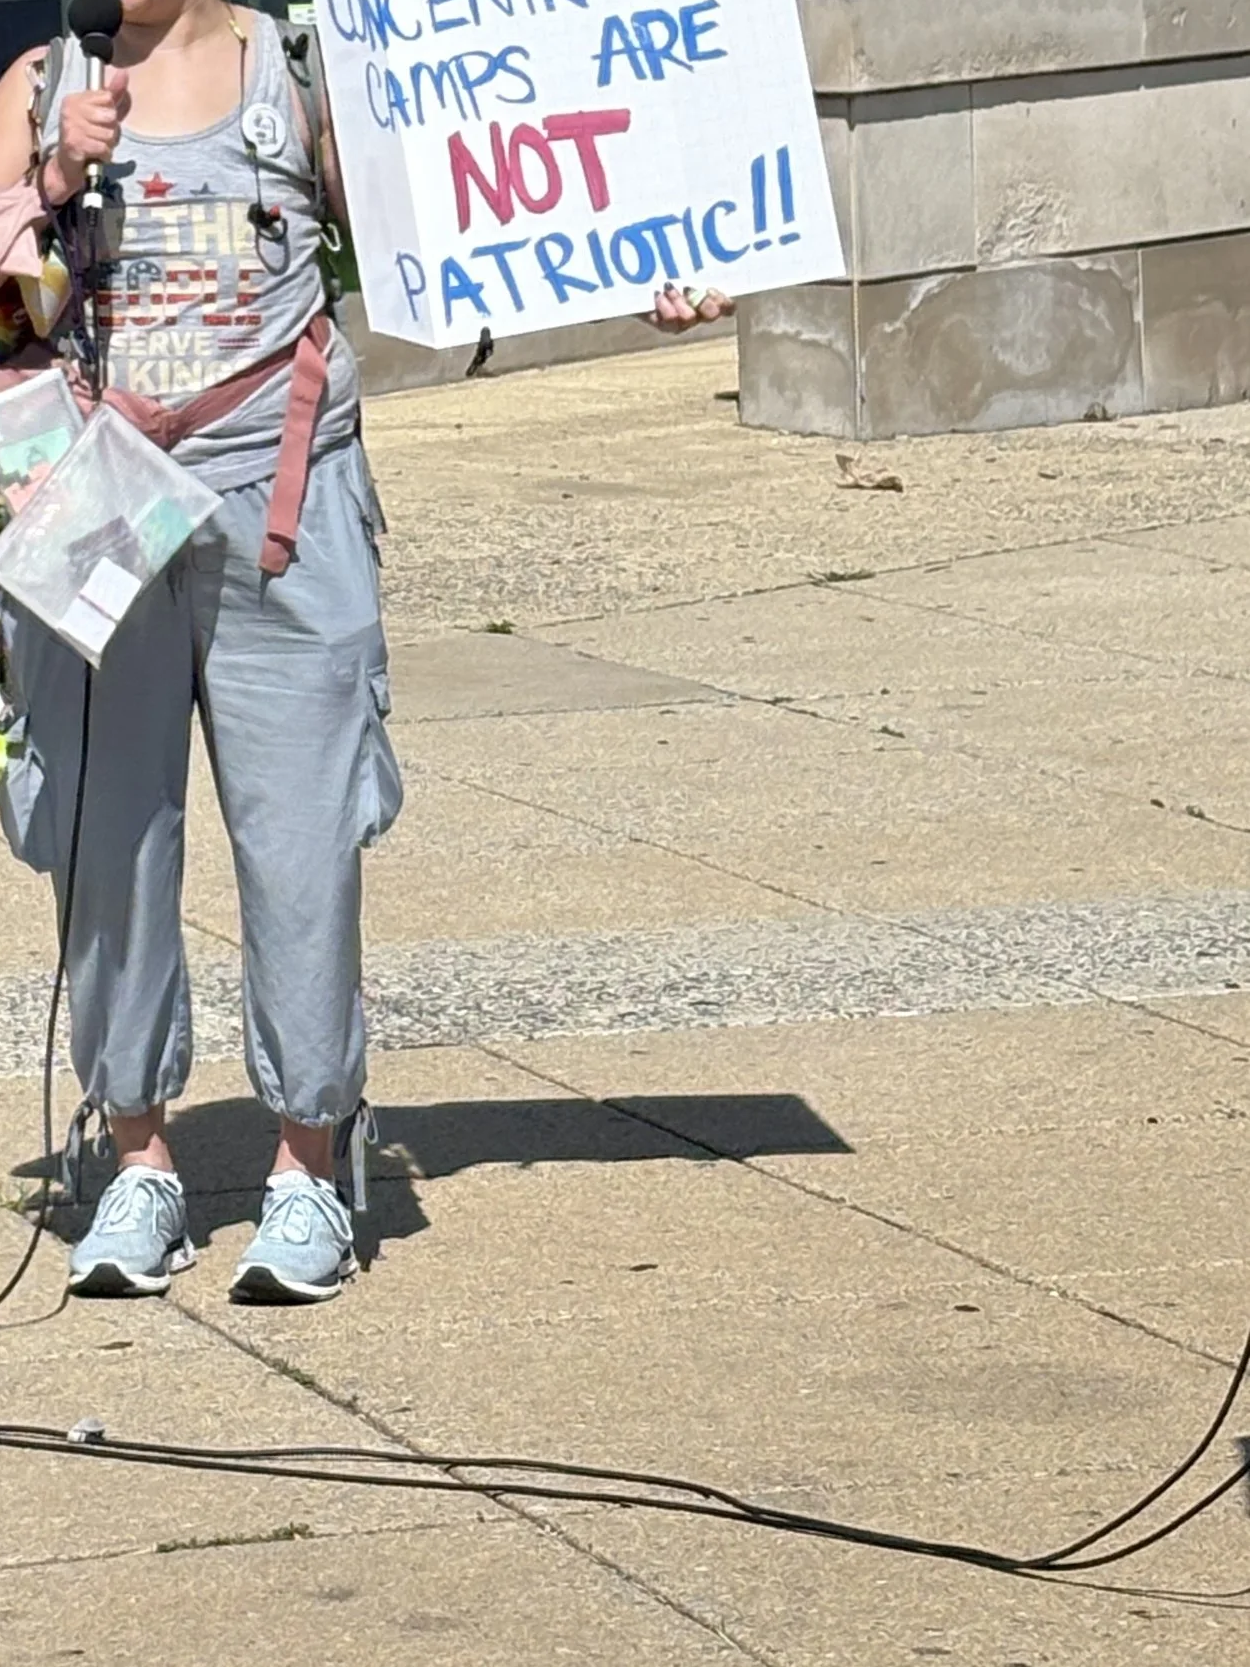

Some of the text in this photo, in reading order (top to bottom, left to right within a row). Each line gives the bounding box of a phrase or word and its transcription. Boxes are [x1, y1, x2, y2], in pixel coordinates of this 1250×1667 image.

[366, 45, 536, 132] CAMPS
[448, 108, 631, 233] NOT
[396, 145, 801, 327] PATRIOTIC!!
[109, 330, 213, 357] SERVE
